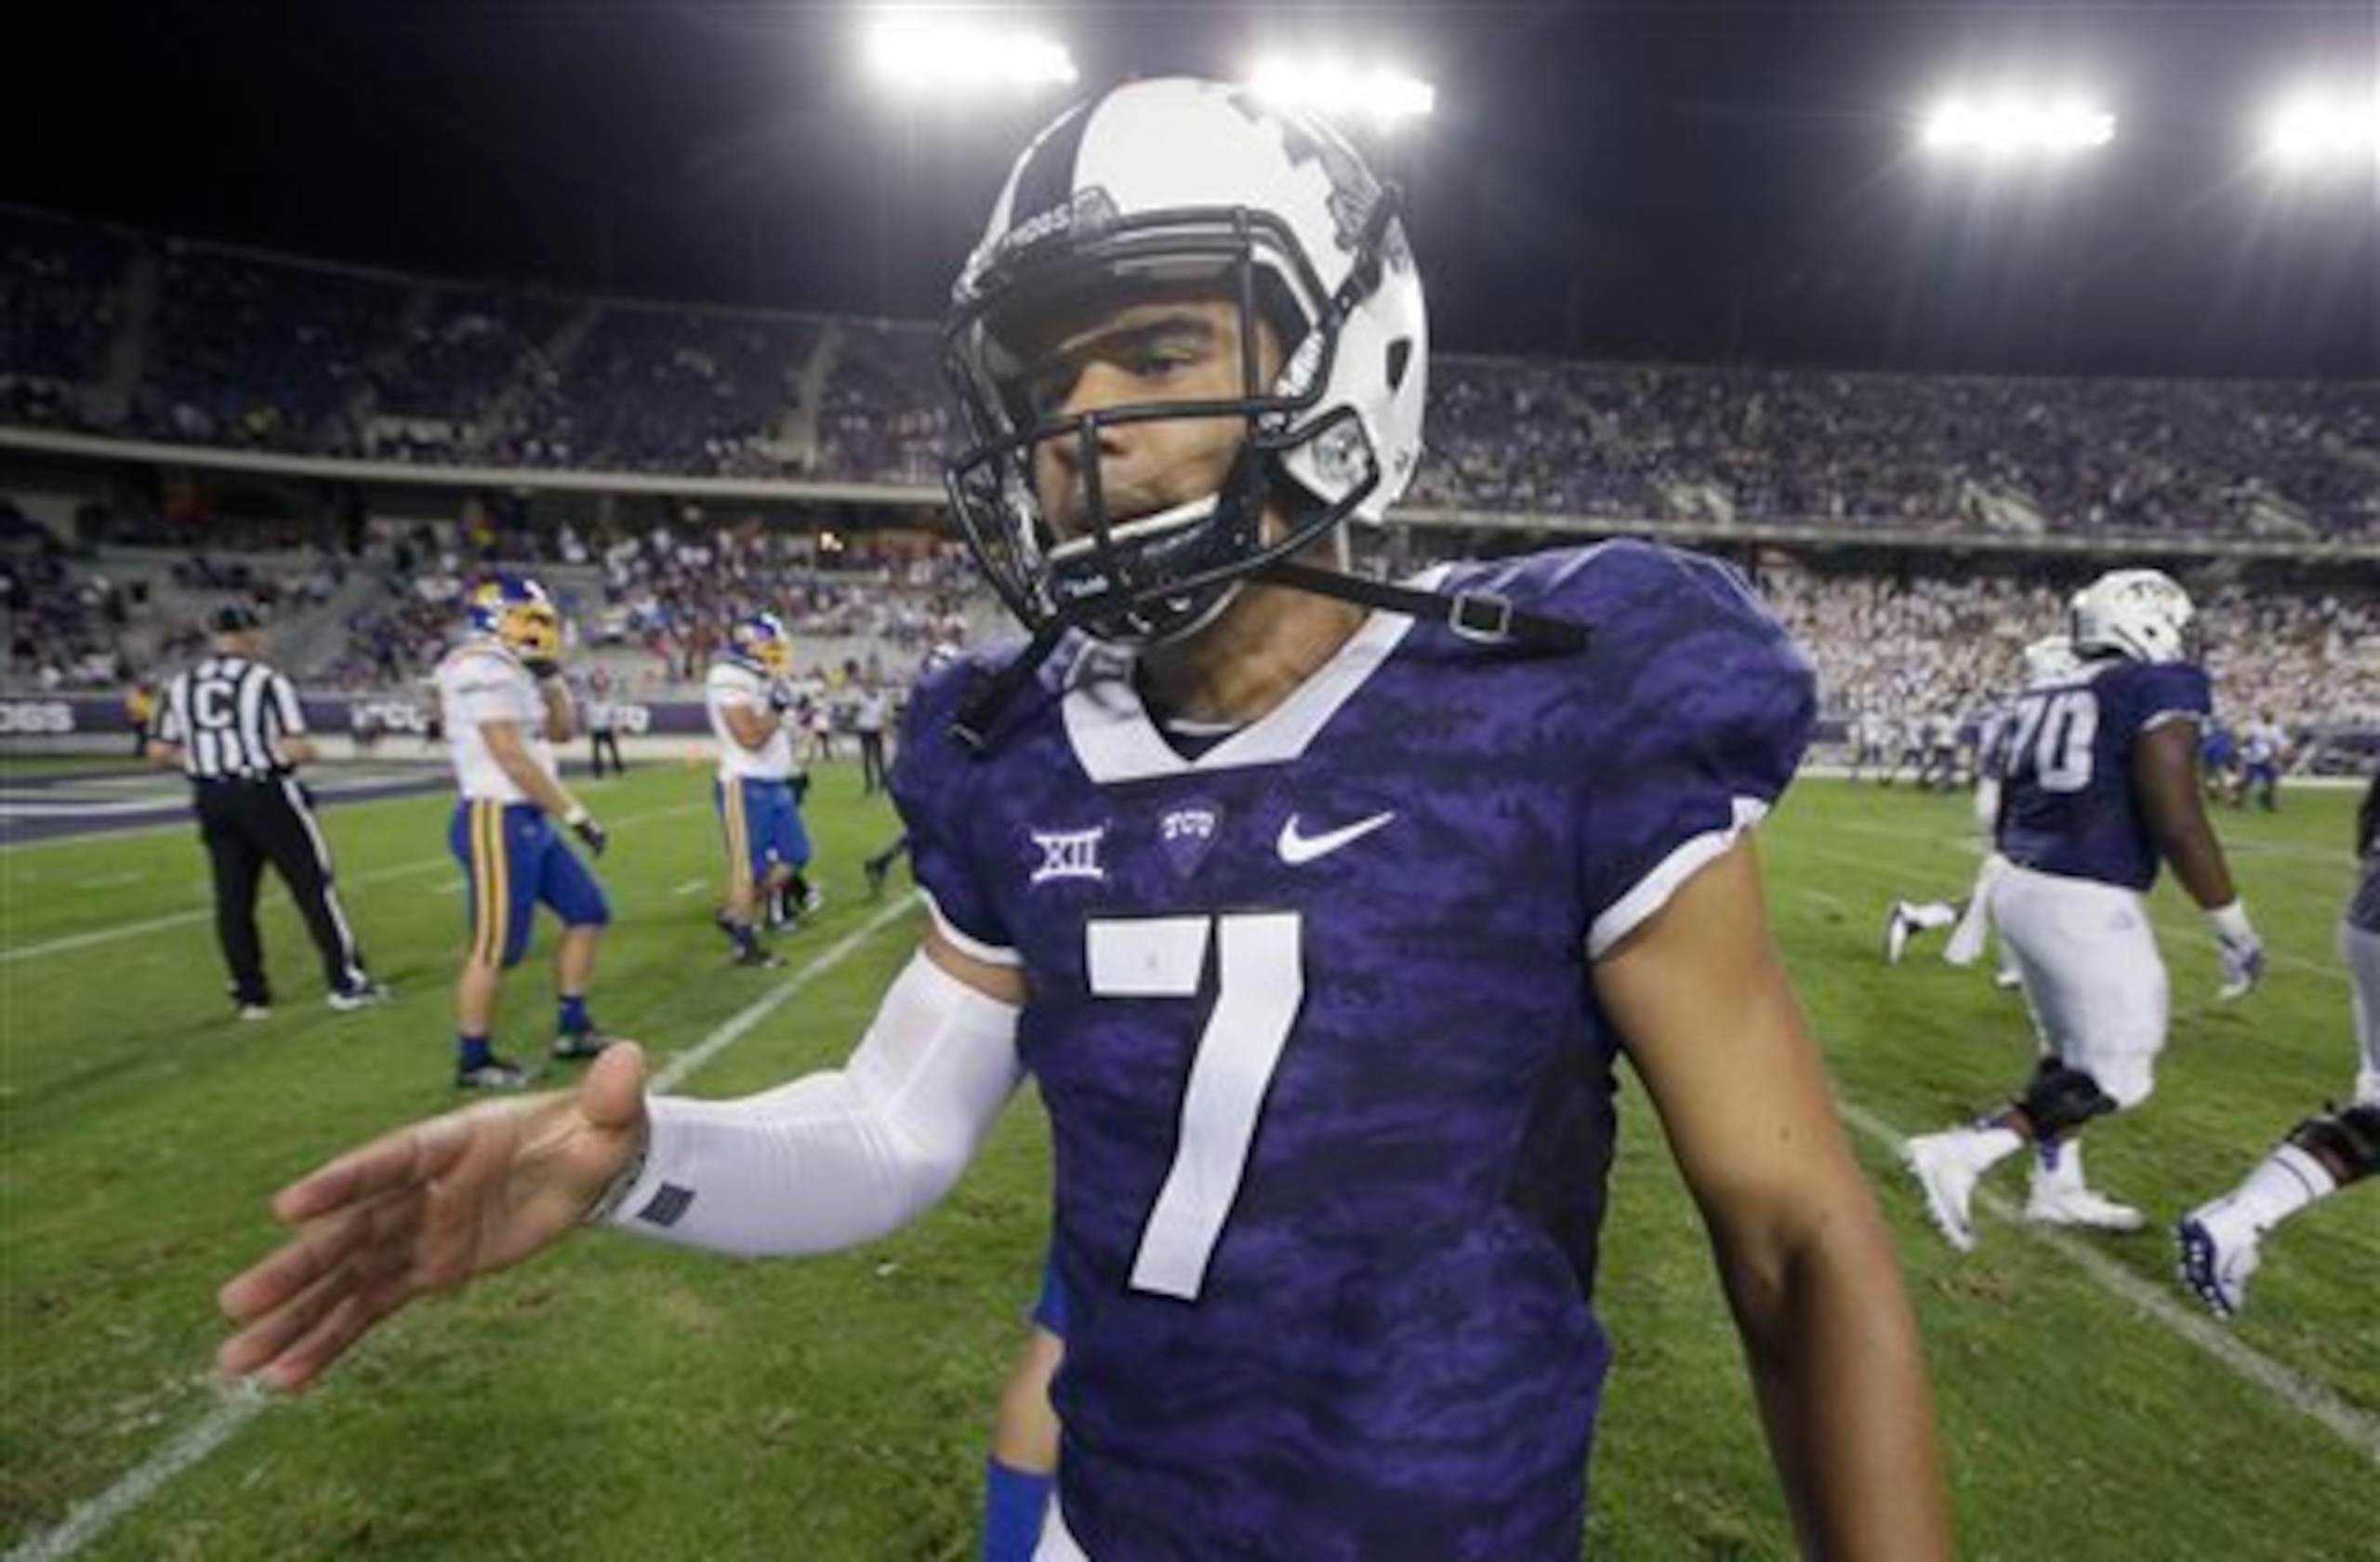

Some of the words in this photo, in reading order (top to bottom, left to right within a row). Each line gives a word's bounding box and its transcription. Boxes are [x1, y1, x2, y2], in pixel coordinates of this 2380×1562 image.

[194, 681, 235, 727] C
[2003, 690, 2098, 792] 70
[1030, 827, 1104, 881] XII
[1086, 912, 1303, 1300] 7
